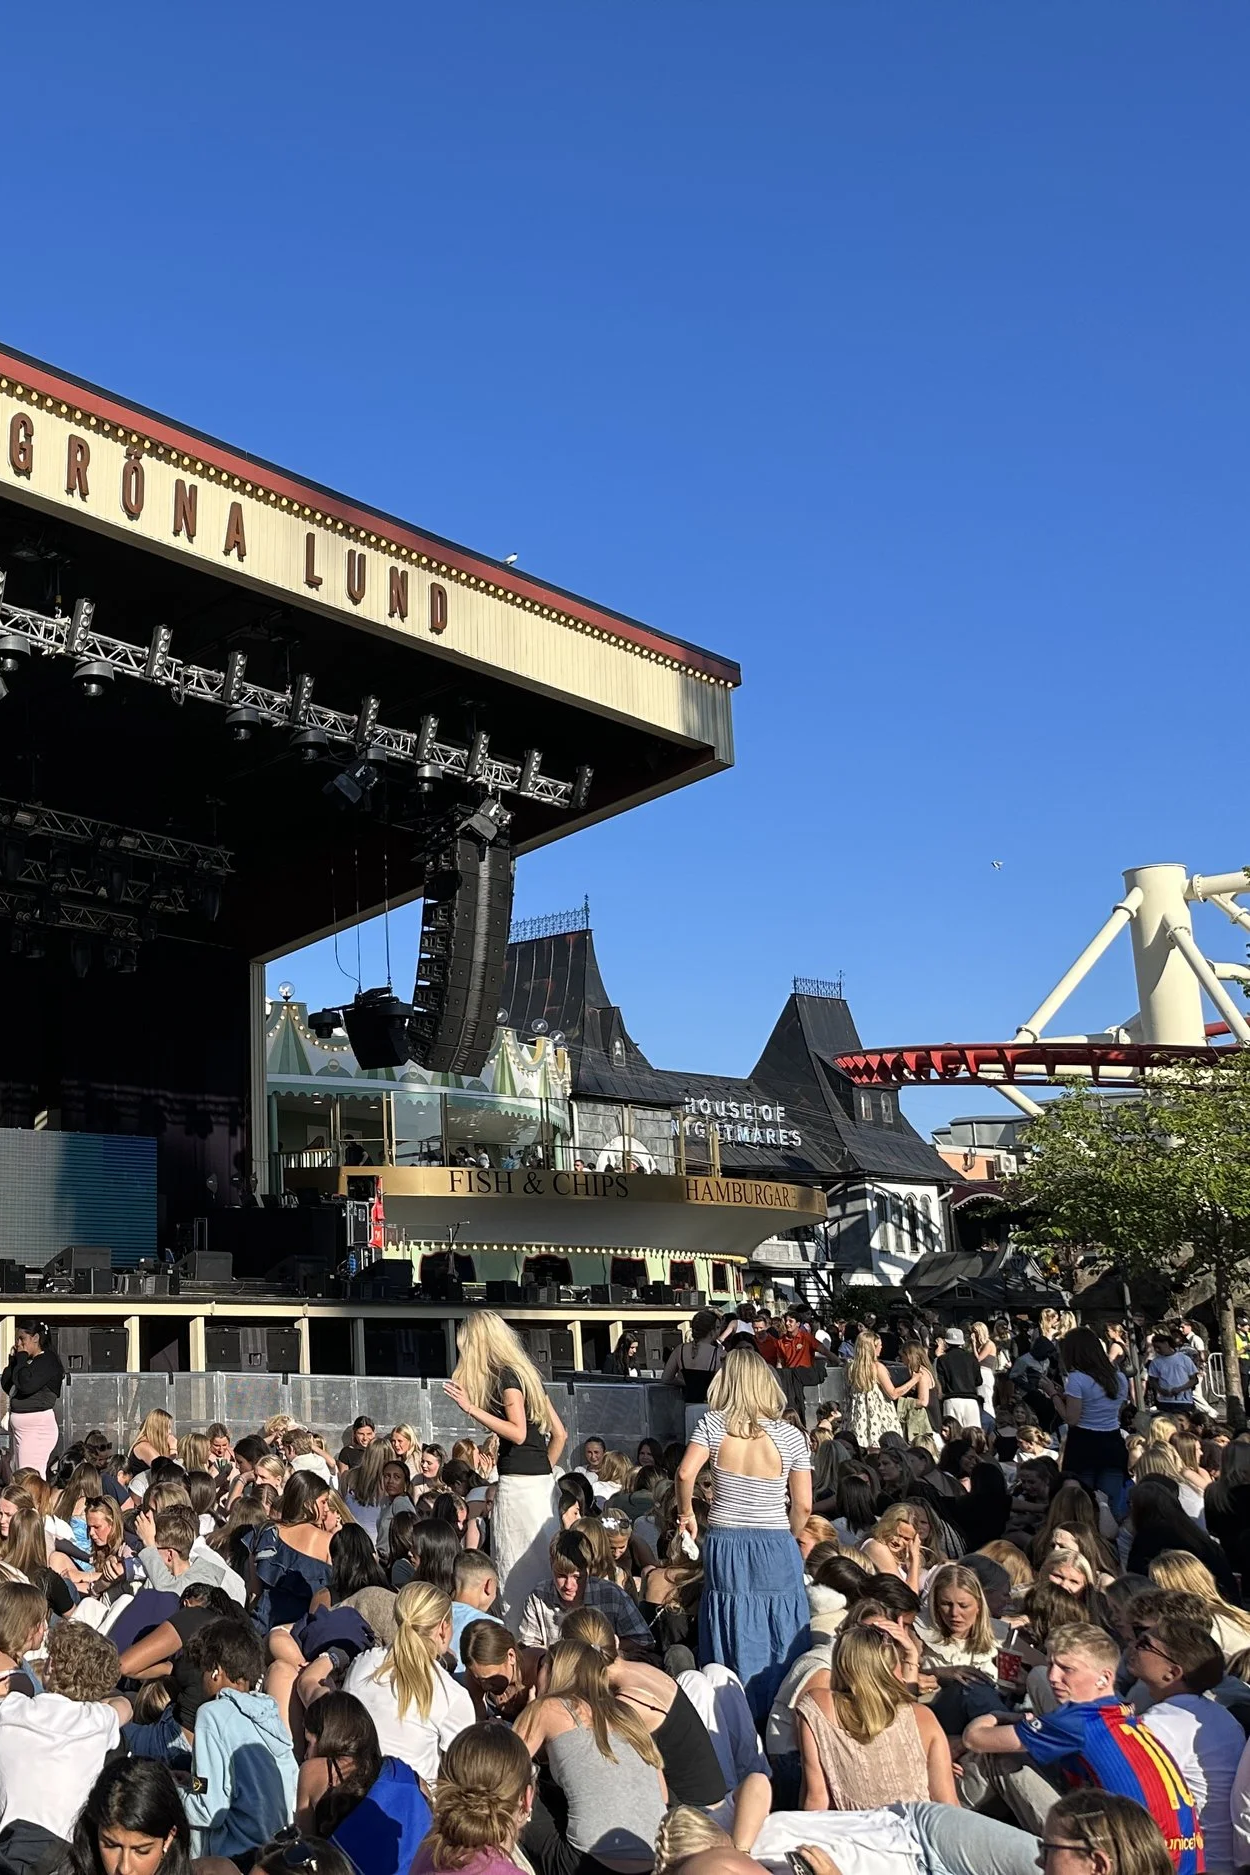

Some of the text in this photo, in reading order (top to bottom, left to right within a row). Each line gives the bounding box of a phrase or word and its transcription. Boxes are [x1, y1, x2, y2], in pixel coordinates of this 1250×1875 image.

[9, 412, 448, 634] GRÖNA LUND
[685, 1097, 786, 1122] HOUSE OF
[448, 1170, 629, 1198] FISH & CHIPS
